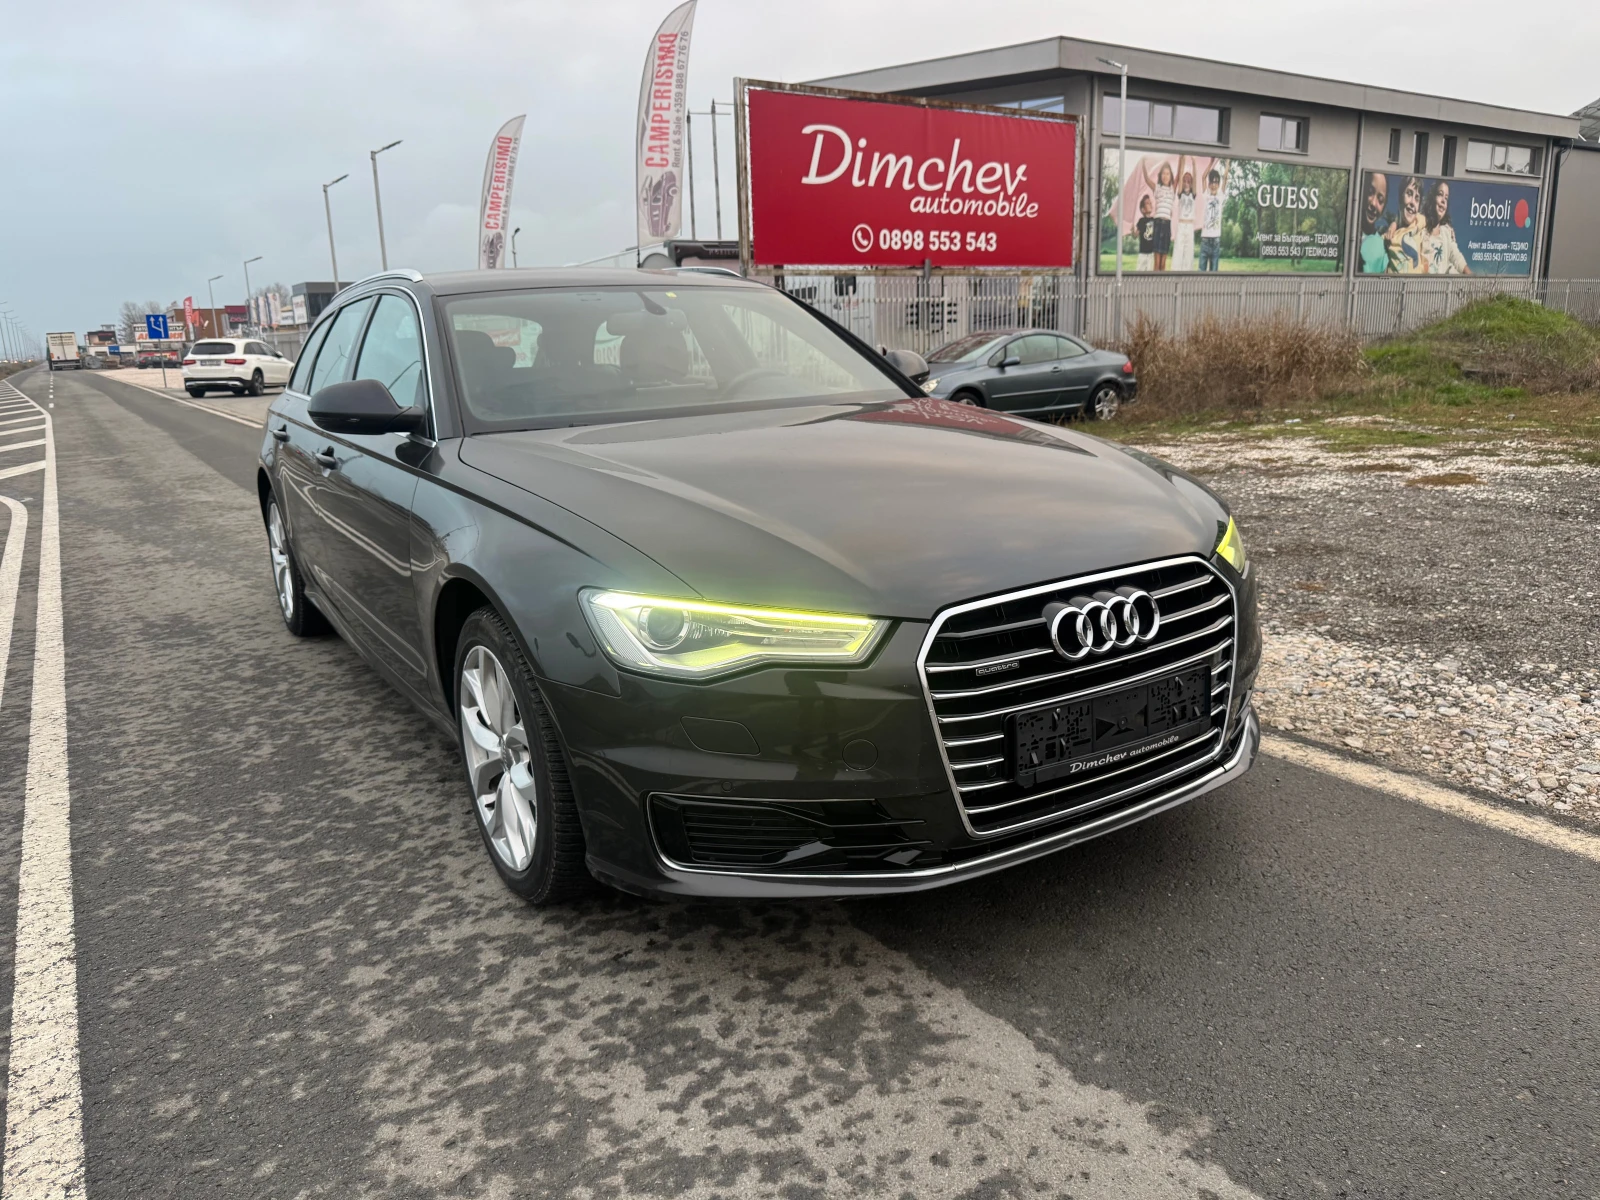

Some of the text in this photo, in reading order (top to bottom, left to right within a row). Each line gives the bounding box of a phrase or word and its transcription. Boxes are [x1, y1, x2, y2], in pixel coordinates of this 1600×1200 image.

[679, 31, 689, 42] 76
[677, 45, 687, 56] 76
[676, 59, 686, 69] 67
[675, 72, 684, 89] 888
[645, 32, 679, 168] CAMPERISIMO
[674, 92, 684, 114] +359
[673, 116, 682, 136] Sale
[672, 148, 682, 168] Rent
[801, 124, 1027, 195] Dimchev
[484, 136, 513, 230] CAMPERISIMO
[910, 192, 1039, 218] automobile
[1257, 184, 1319, 210] GUESS
[1470, 197, 1512, 220] boboli
[1469, 219, 1509, 228] barcelona
[879, 228, 997, 252] 0898 553 543
[1255, 232, 1273, 242] Агент
[1273, 234, 1281, 242] за
[1282, 232, 1310, 244] България
[1314, 233, 1339, 245] ТЕДИКО
[1468, 240, 1481, 249] Агент
[1487, 241, 1508, 251] България
[1510, 241, 1529, 251] ТЕДИКО
[1278, 246, 1289, 256] 553
[1290, 246, 1301, 256] 543
[1305, 247, 1338, 258] TEDIKO.BG
[978, 662, 1018, 675] quattro
[1069, 735, 1179, 774] Dimchev automobile
